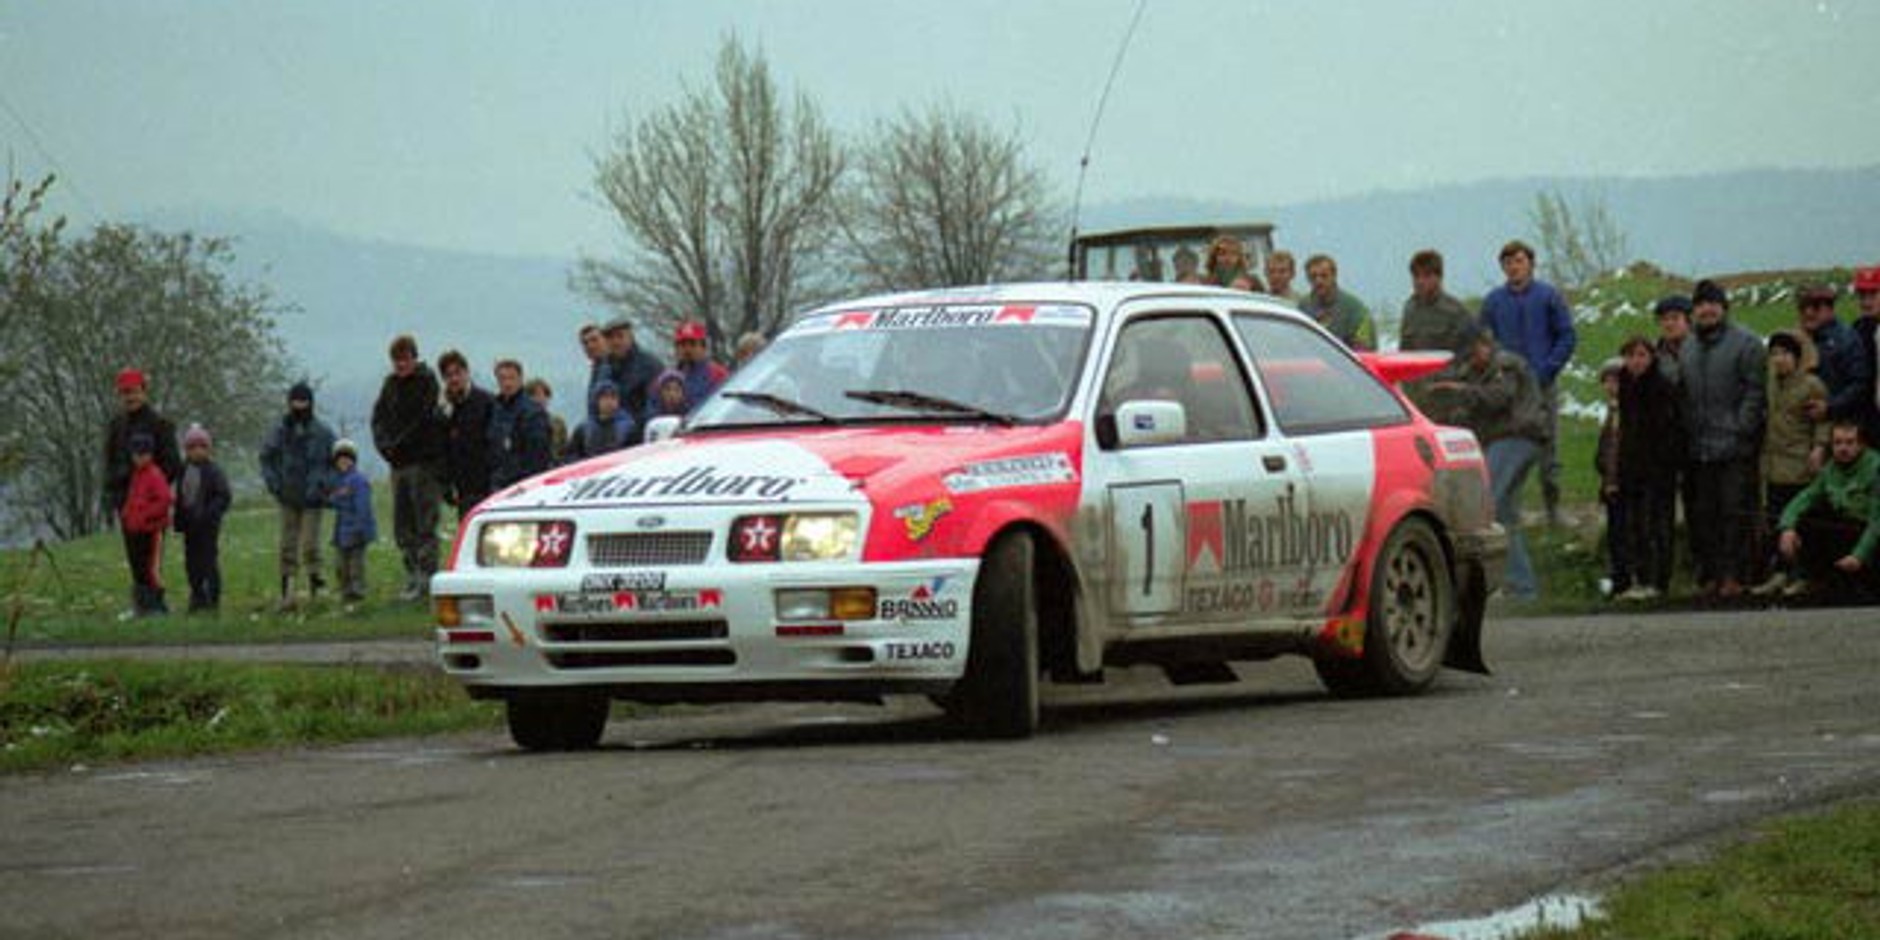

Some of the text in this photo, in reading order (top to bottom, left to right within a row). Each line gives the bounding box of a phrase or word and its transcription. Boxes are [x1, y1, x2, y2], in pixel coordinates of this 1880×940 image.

[871, 304, 993, 329] Marlboro
[564, 466, 797, 501] Marlboro
[1141, 502, 1153, 596] 1
[1223, 496, 1353, 571] Marlboro
[885, 642, 955, 659] TEXACO
